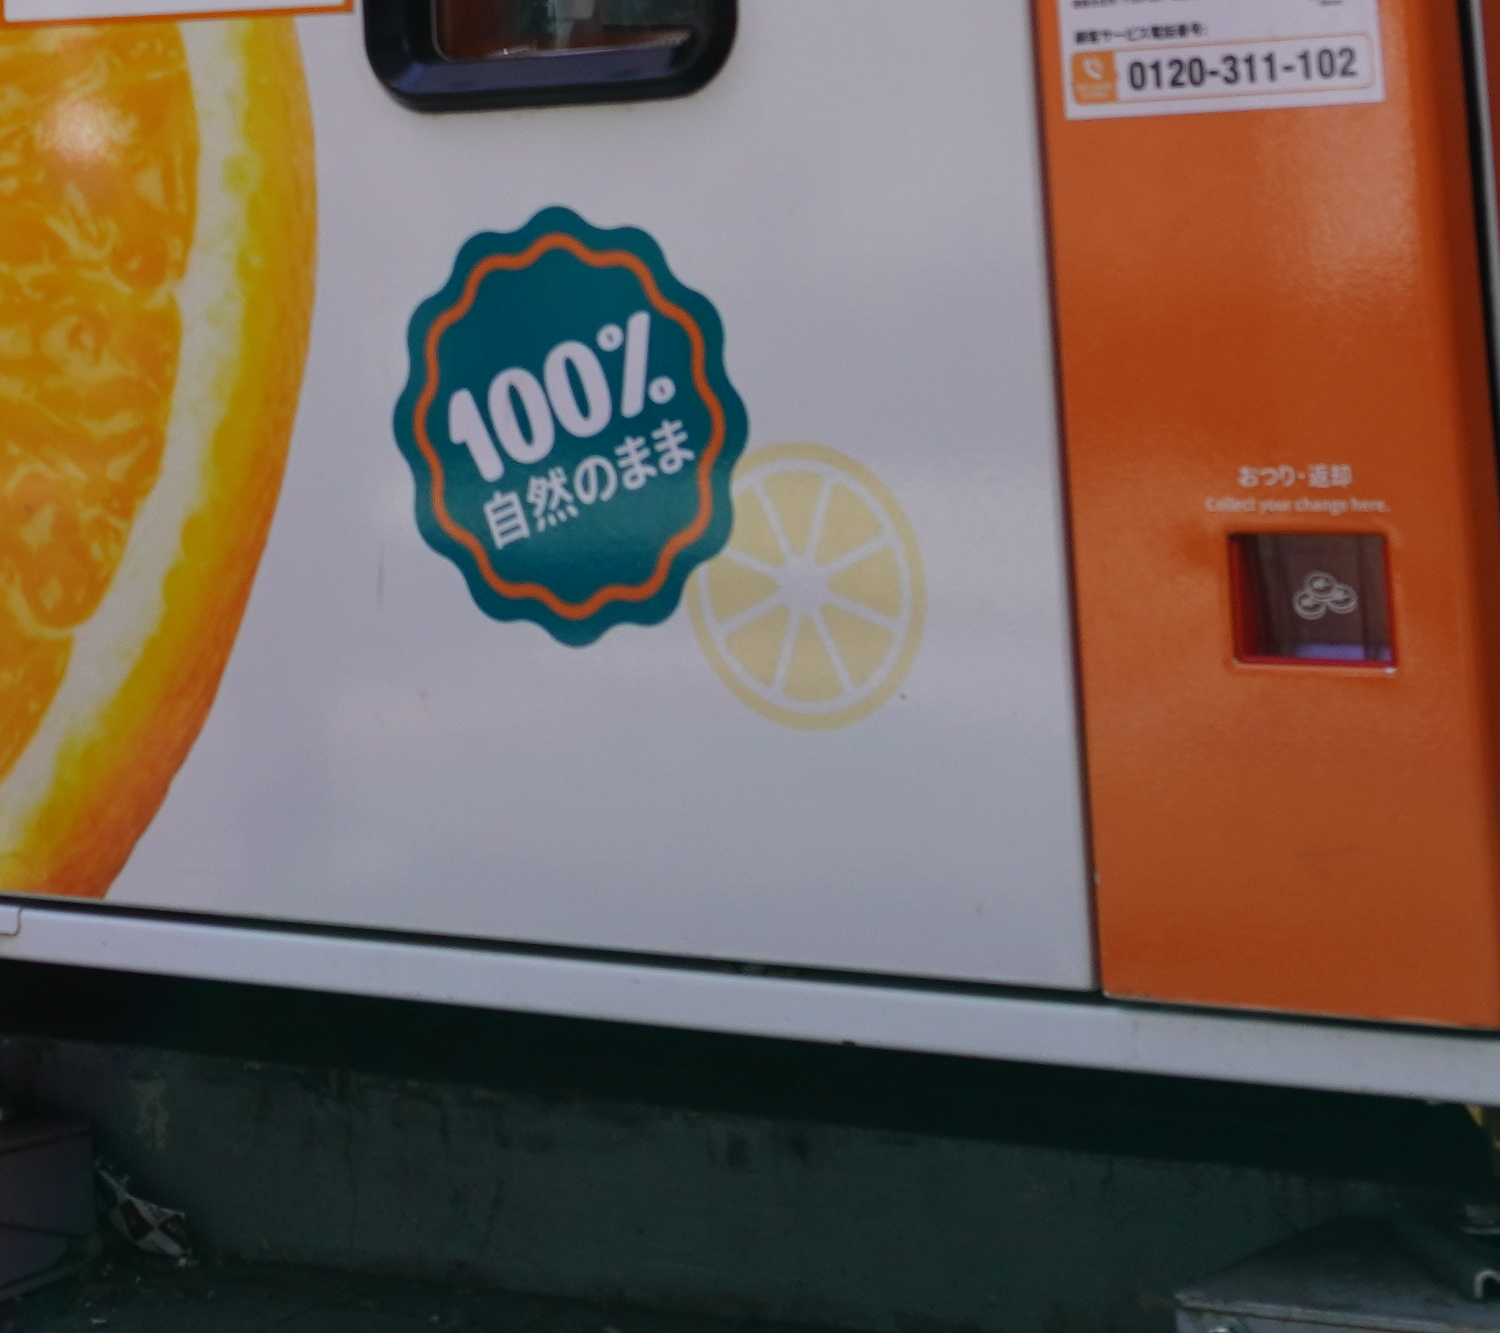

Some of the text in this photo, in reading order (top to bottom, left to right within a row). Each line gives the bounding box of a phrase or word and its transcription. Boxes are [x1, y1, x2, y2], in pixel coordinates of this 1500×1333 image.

[1129, 46, 1359, 92] 0120-311-102
[447, 309, 677, 483] 100%
[482, 418, 696, 551] 自然のまま
